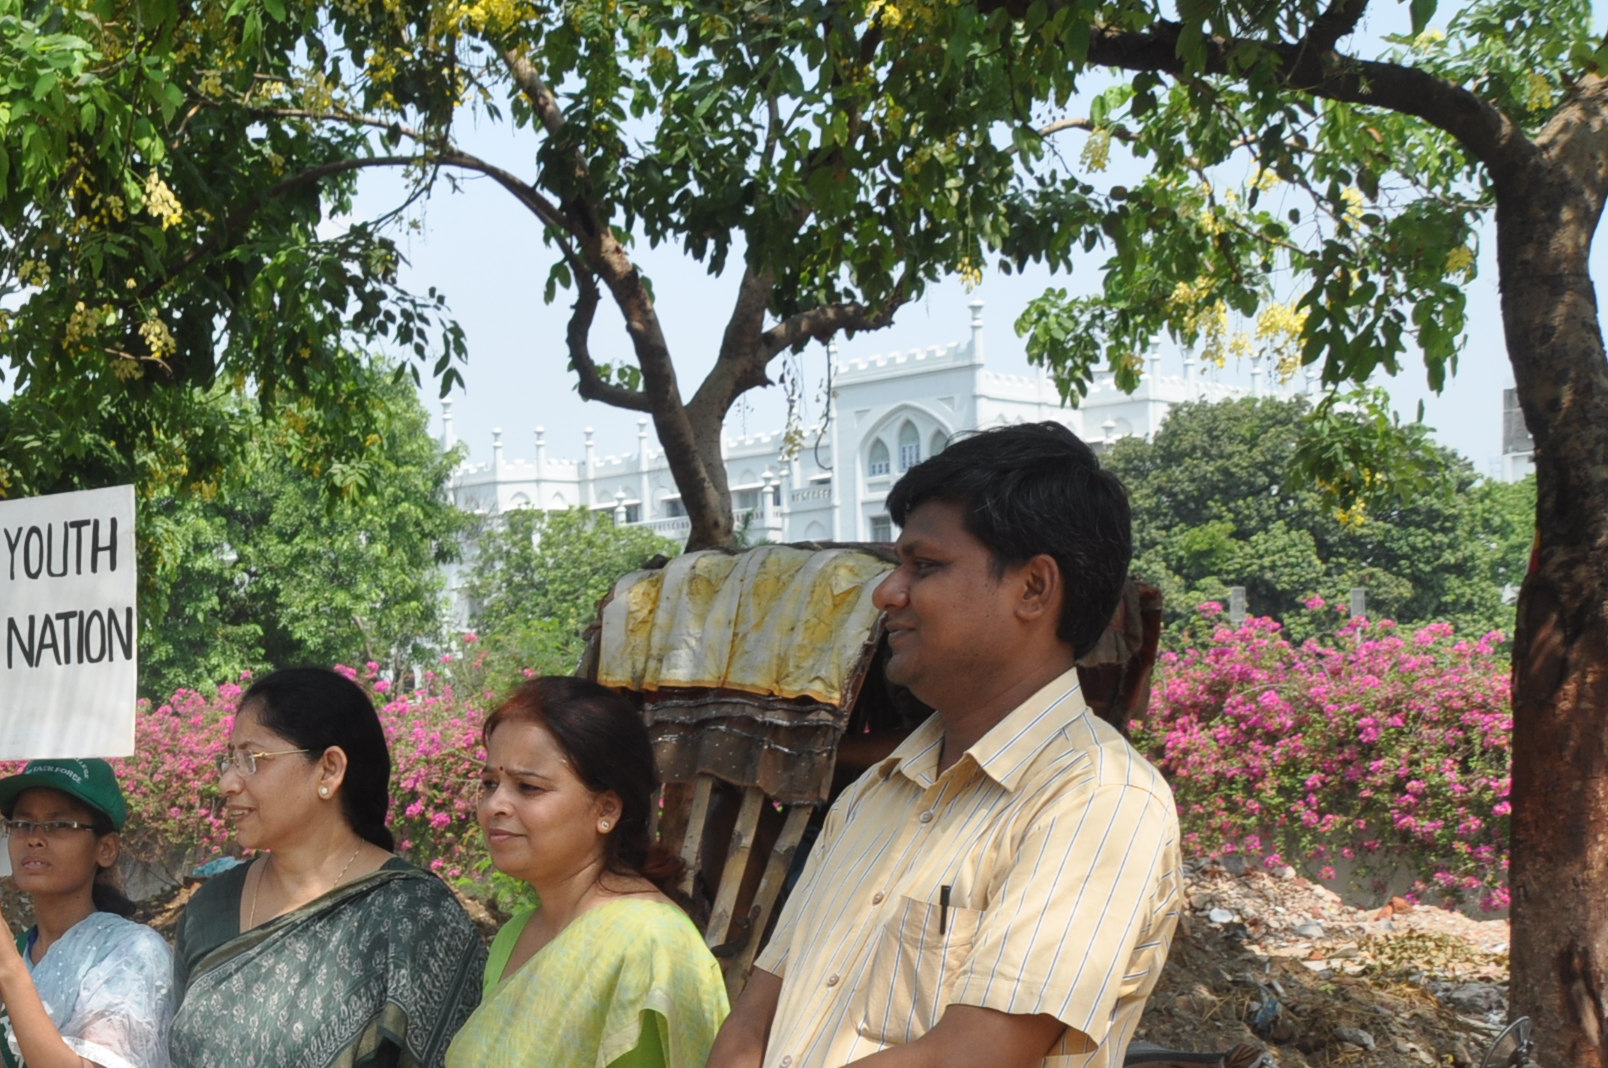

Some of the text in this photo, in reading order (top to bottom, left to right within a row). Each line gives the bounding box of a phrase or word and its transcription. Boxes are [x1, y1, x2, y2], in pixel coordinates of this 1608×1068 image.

[4, 517, 118, 581] YOUTH
[6, 607, 133, 669] NATION
[54, 767, 83, 784] FORCE
